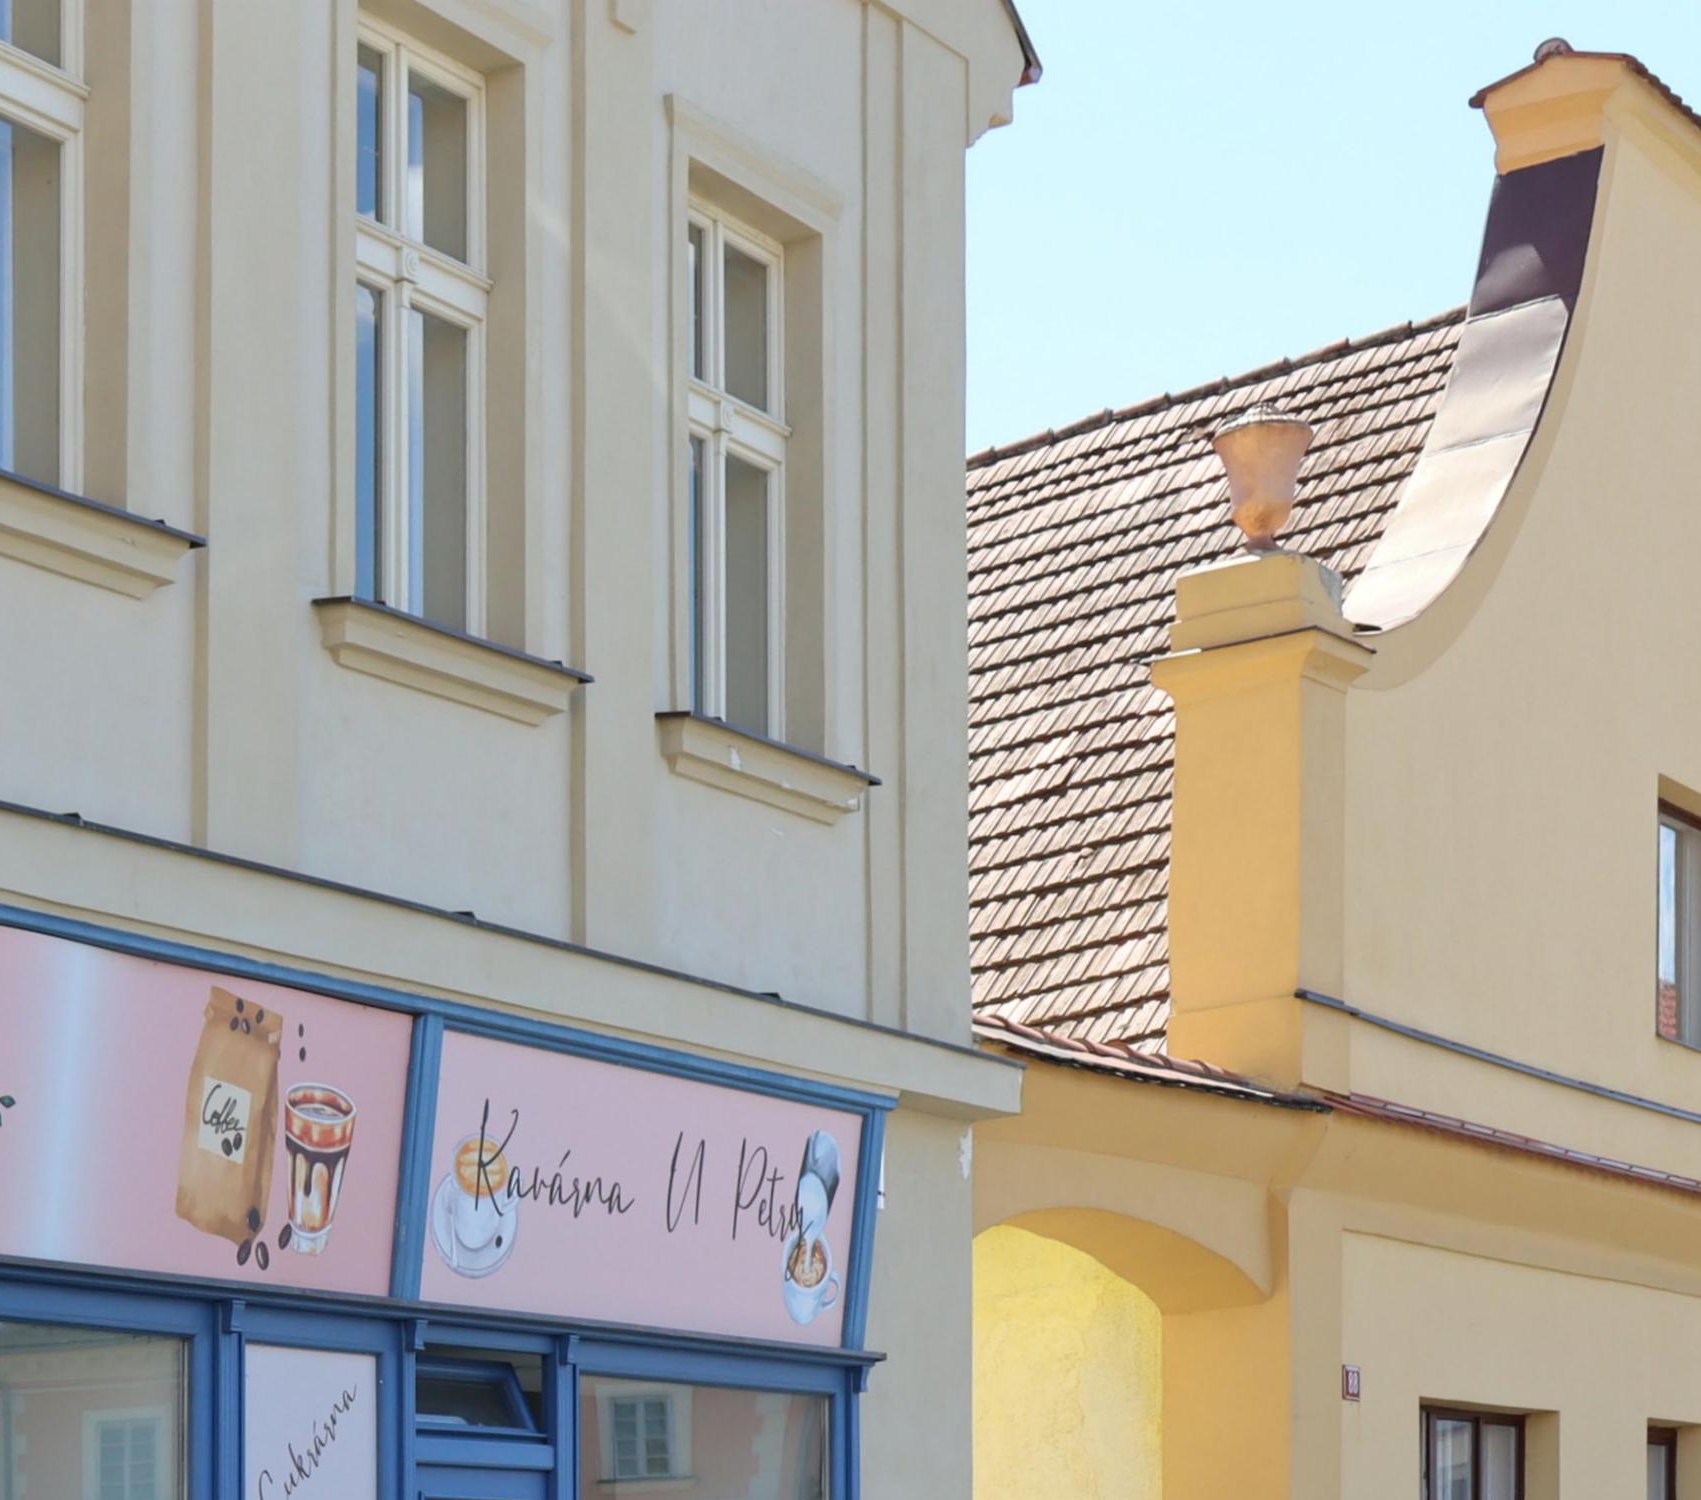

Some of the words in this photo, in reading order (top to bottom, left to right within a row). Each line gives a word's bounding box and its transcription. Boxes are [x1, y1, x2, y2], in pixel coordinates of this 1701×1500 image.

[202, 1083, 245, 1135] Coffee
[474, 1097, 636, 1219] Kavárna
[666, 1130, 705, 1233] U
[732, 1137, 814, 1282] Petry
